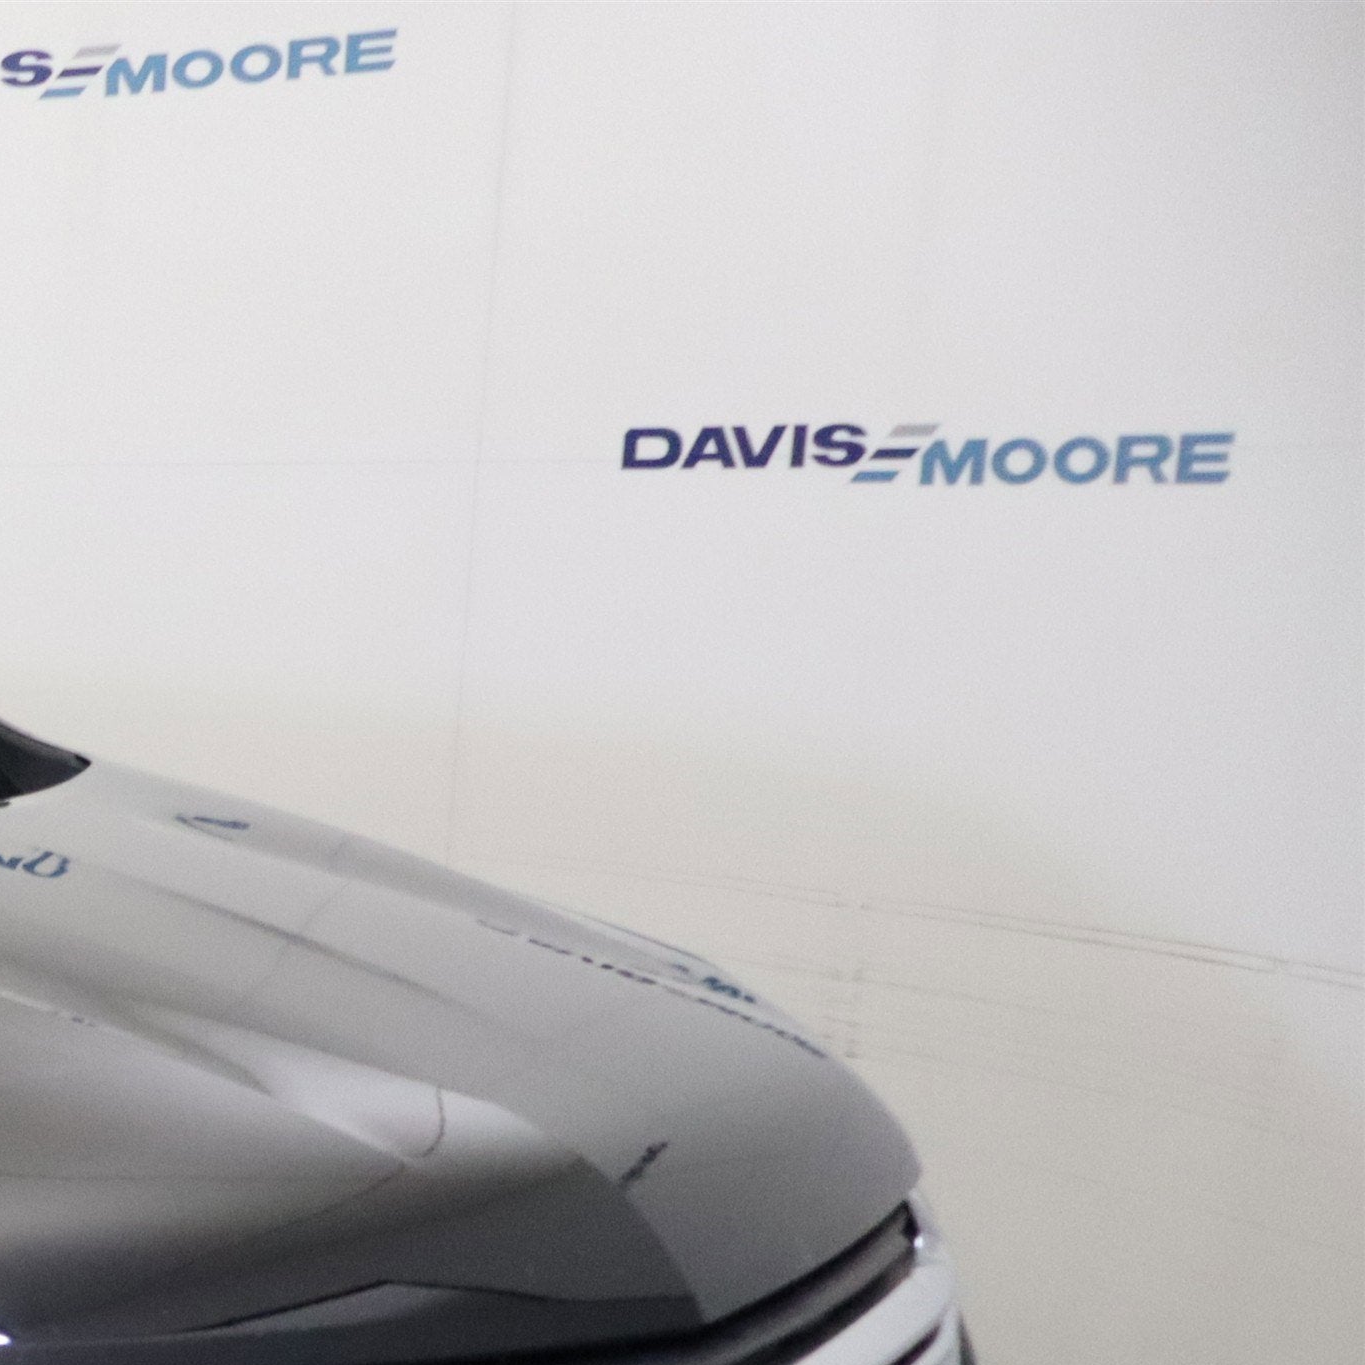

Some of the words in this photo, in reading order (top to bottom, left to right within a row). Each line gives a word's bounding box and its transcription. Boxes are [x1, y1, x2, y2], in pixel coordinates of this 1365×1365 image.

[105, 28, 397, 96] MOORE
[621, 424, 866, 469] DAVIS
[919, 433, 1235, 485] MOORE
